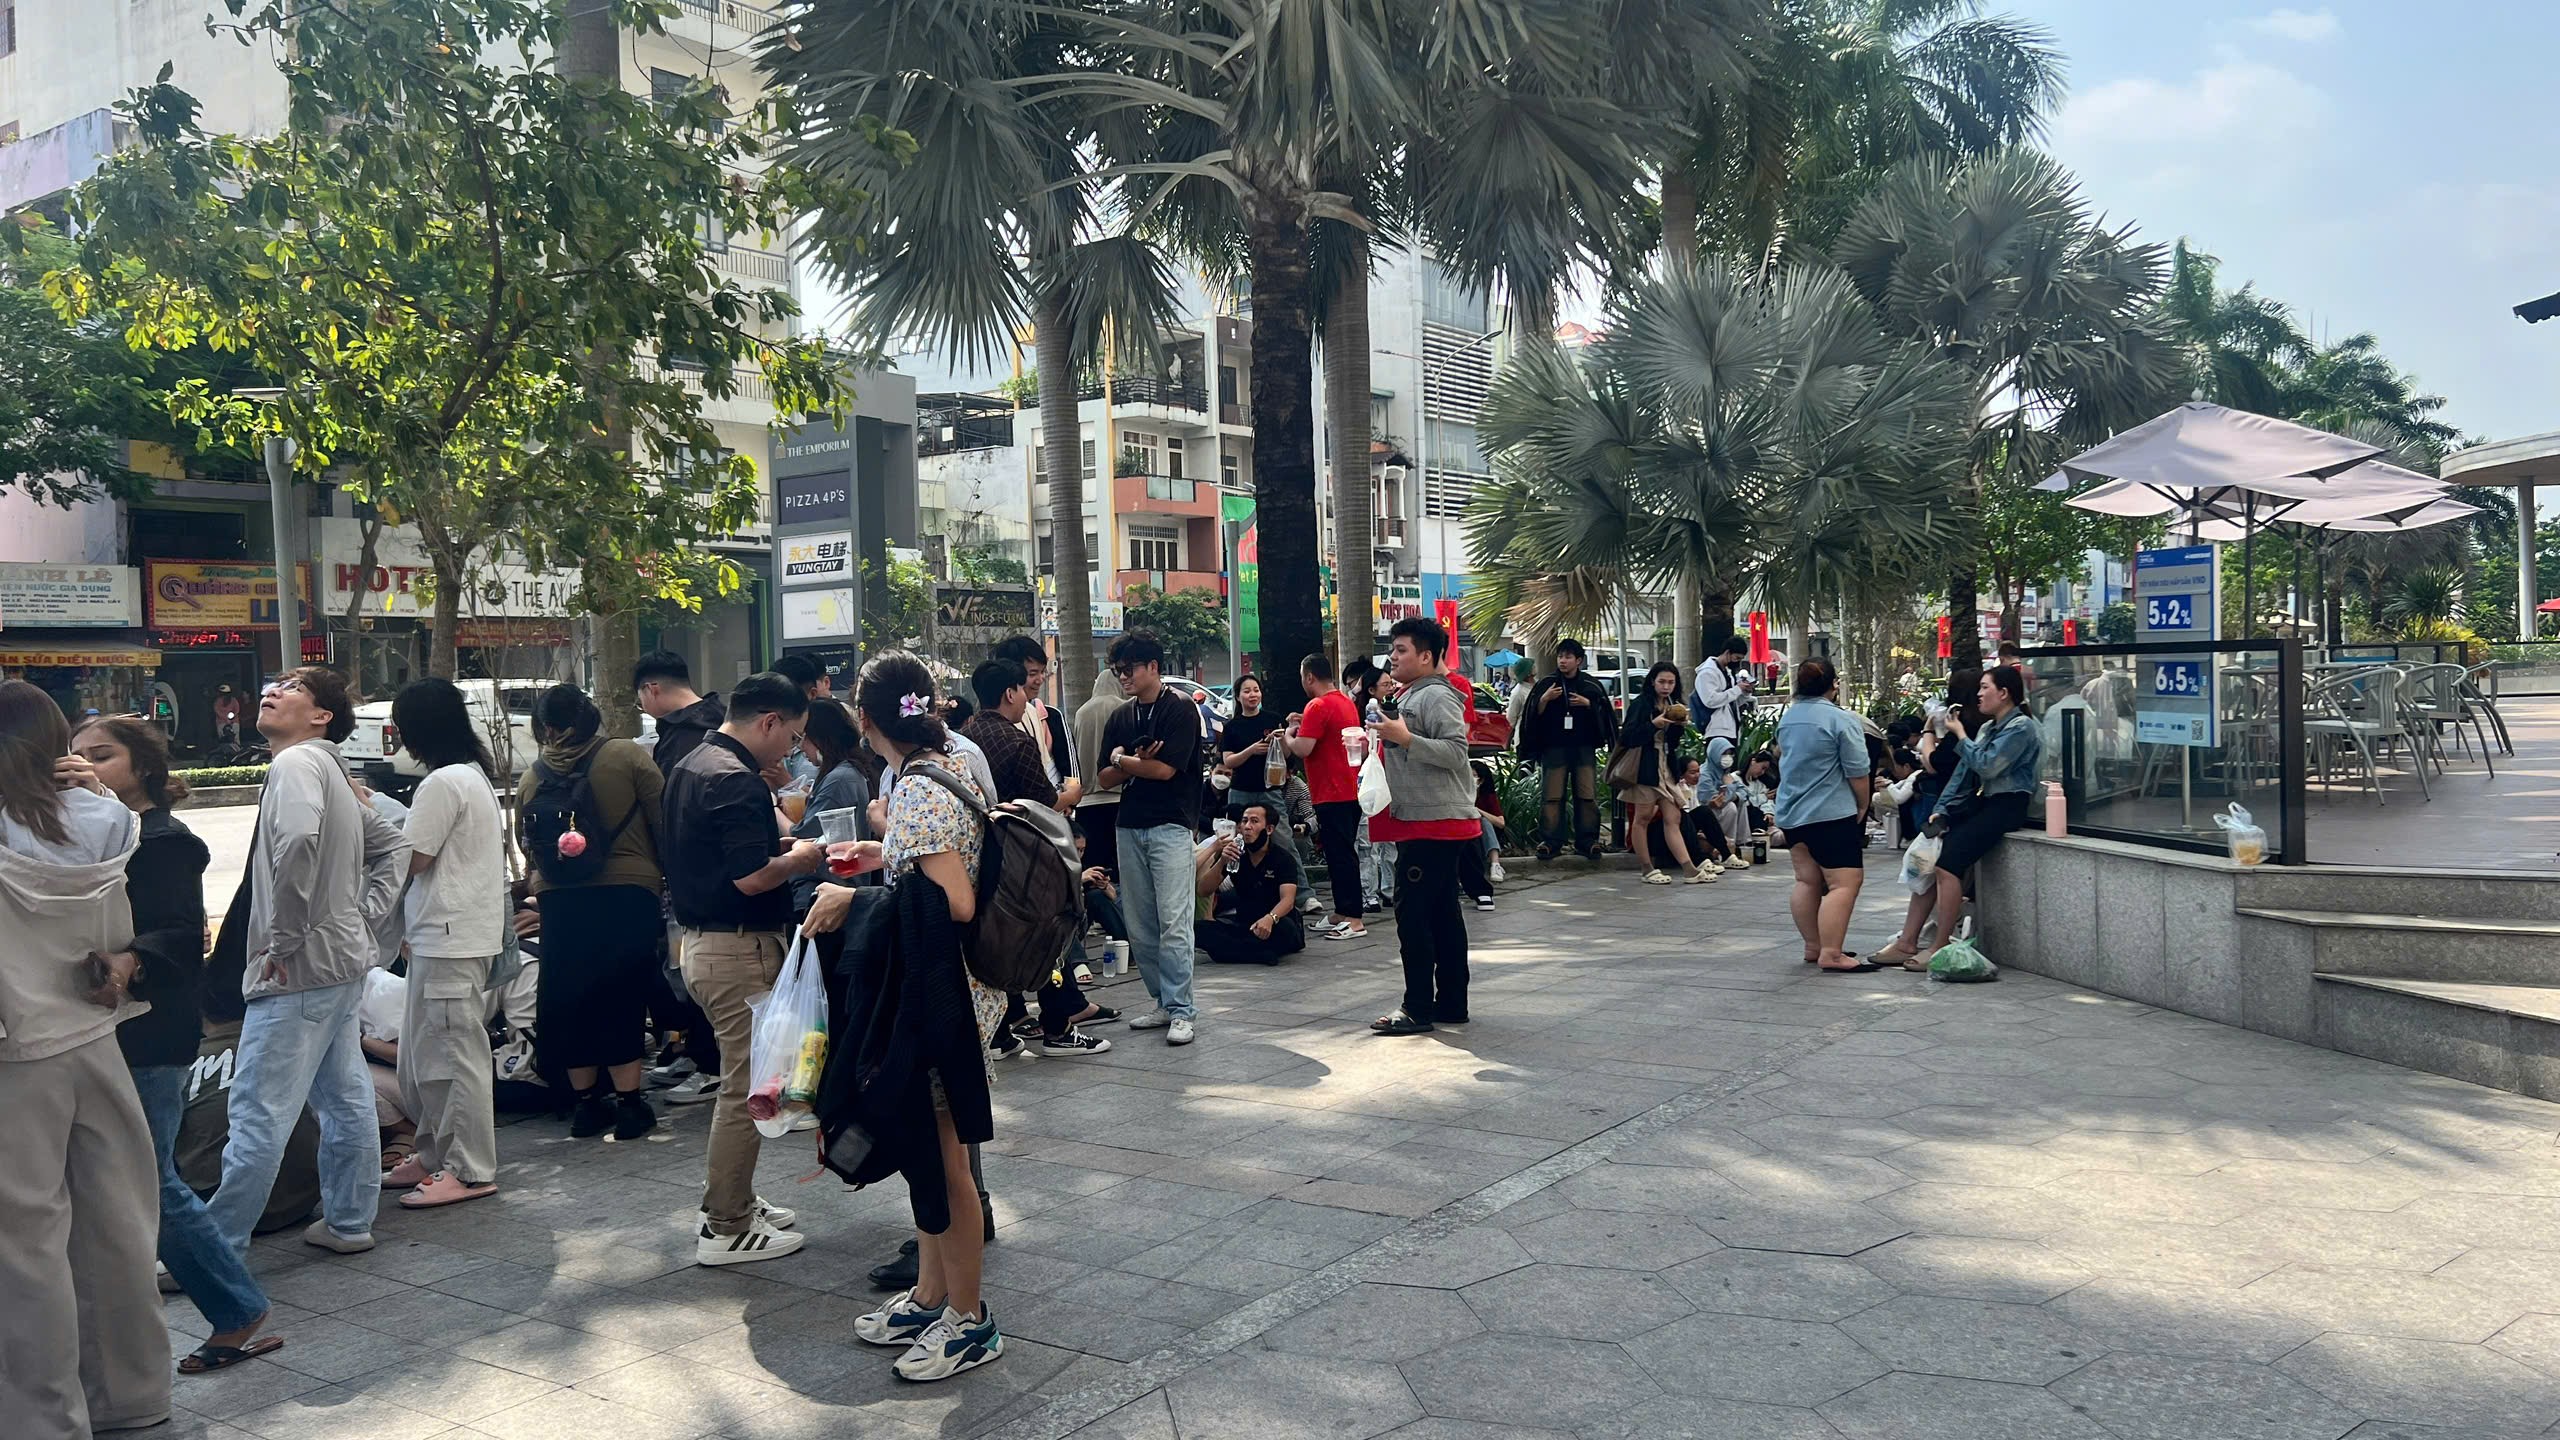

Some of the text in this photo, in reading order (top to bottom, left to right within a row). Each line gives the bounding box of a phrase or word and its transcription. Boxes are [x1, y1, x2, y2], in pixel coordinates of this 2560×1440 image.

[787, 439, 850, 458] THE EMPORIUM
[785, 489, 846, 508] PIZZA 4P'S
[788, 540, 848, 562] 永大电梯
[791, 560, 839, 574] YUNGTAY
[1238, 571, 1250, 583] et
[335, 563, 428, 595] HOT
[511, 581, 543, 607] THE
[1380, 599, 1402, 623] VIỆT
[2148, 600, 2191, 625] 5,2%
[2155, 665, 2199, 693] 6,5%
